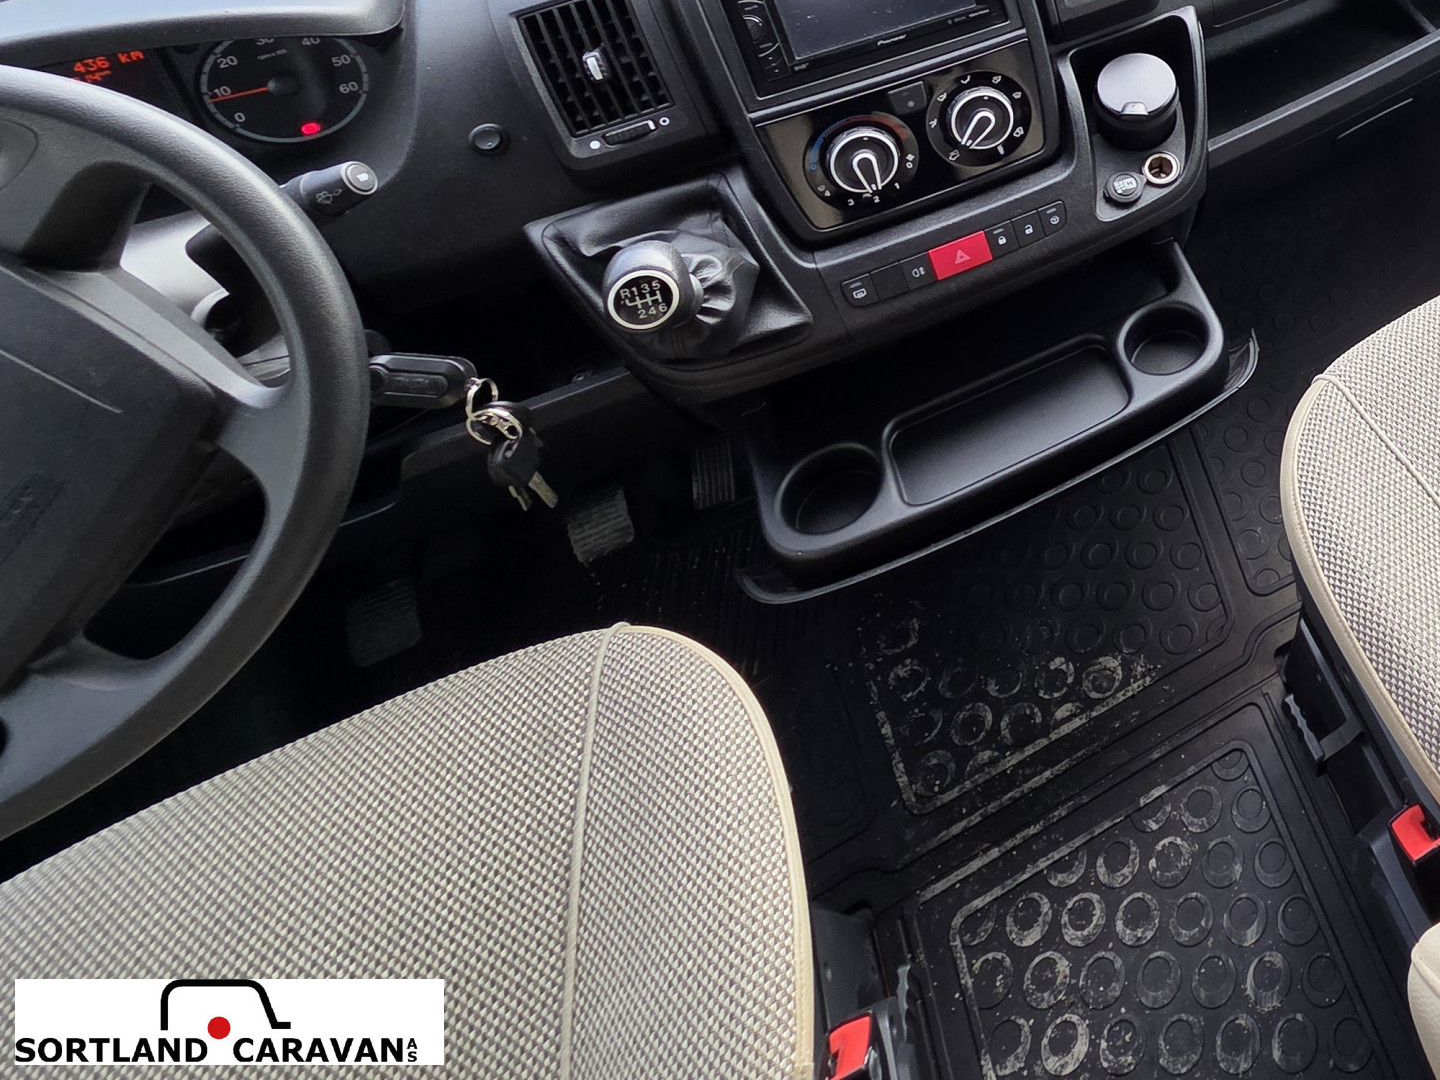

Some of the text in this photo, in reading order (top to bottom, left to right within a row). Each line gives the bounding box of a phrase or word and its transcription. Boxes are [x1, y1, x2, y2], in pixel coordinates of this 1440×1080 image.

[74, 56, 110, 73] 436
[217, 55, 238, 69] 20
[331, 54, 351, 67] 50
[214, 86, 232, 97] 10
[339, 81, 359, 94] 60
[234, 112, 246, 122] 0
[873, 195, 880, 203] 2
[620, 280, 661, 299] R 1 3 5
[637, 302, 668, 319] 2 4 6
